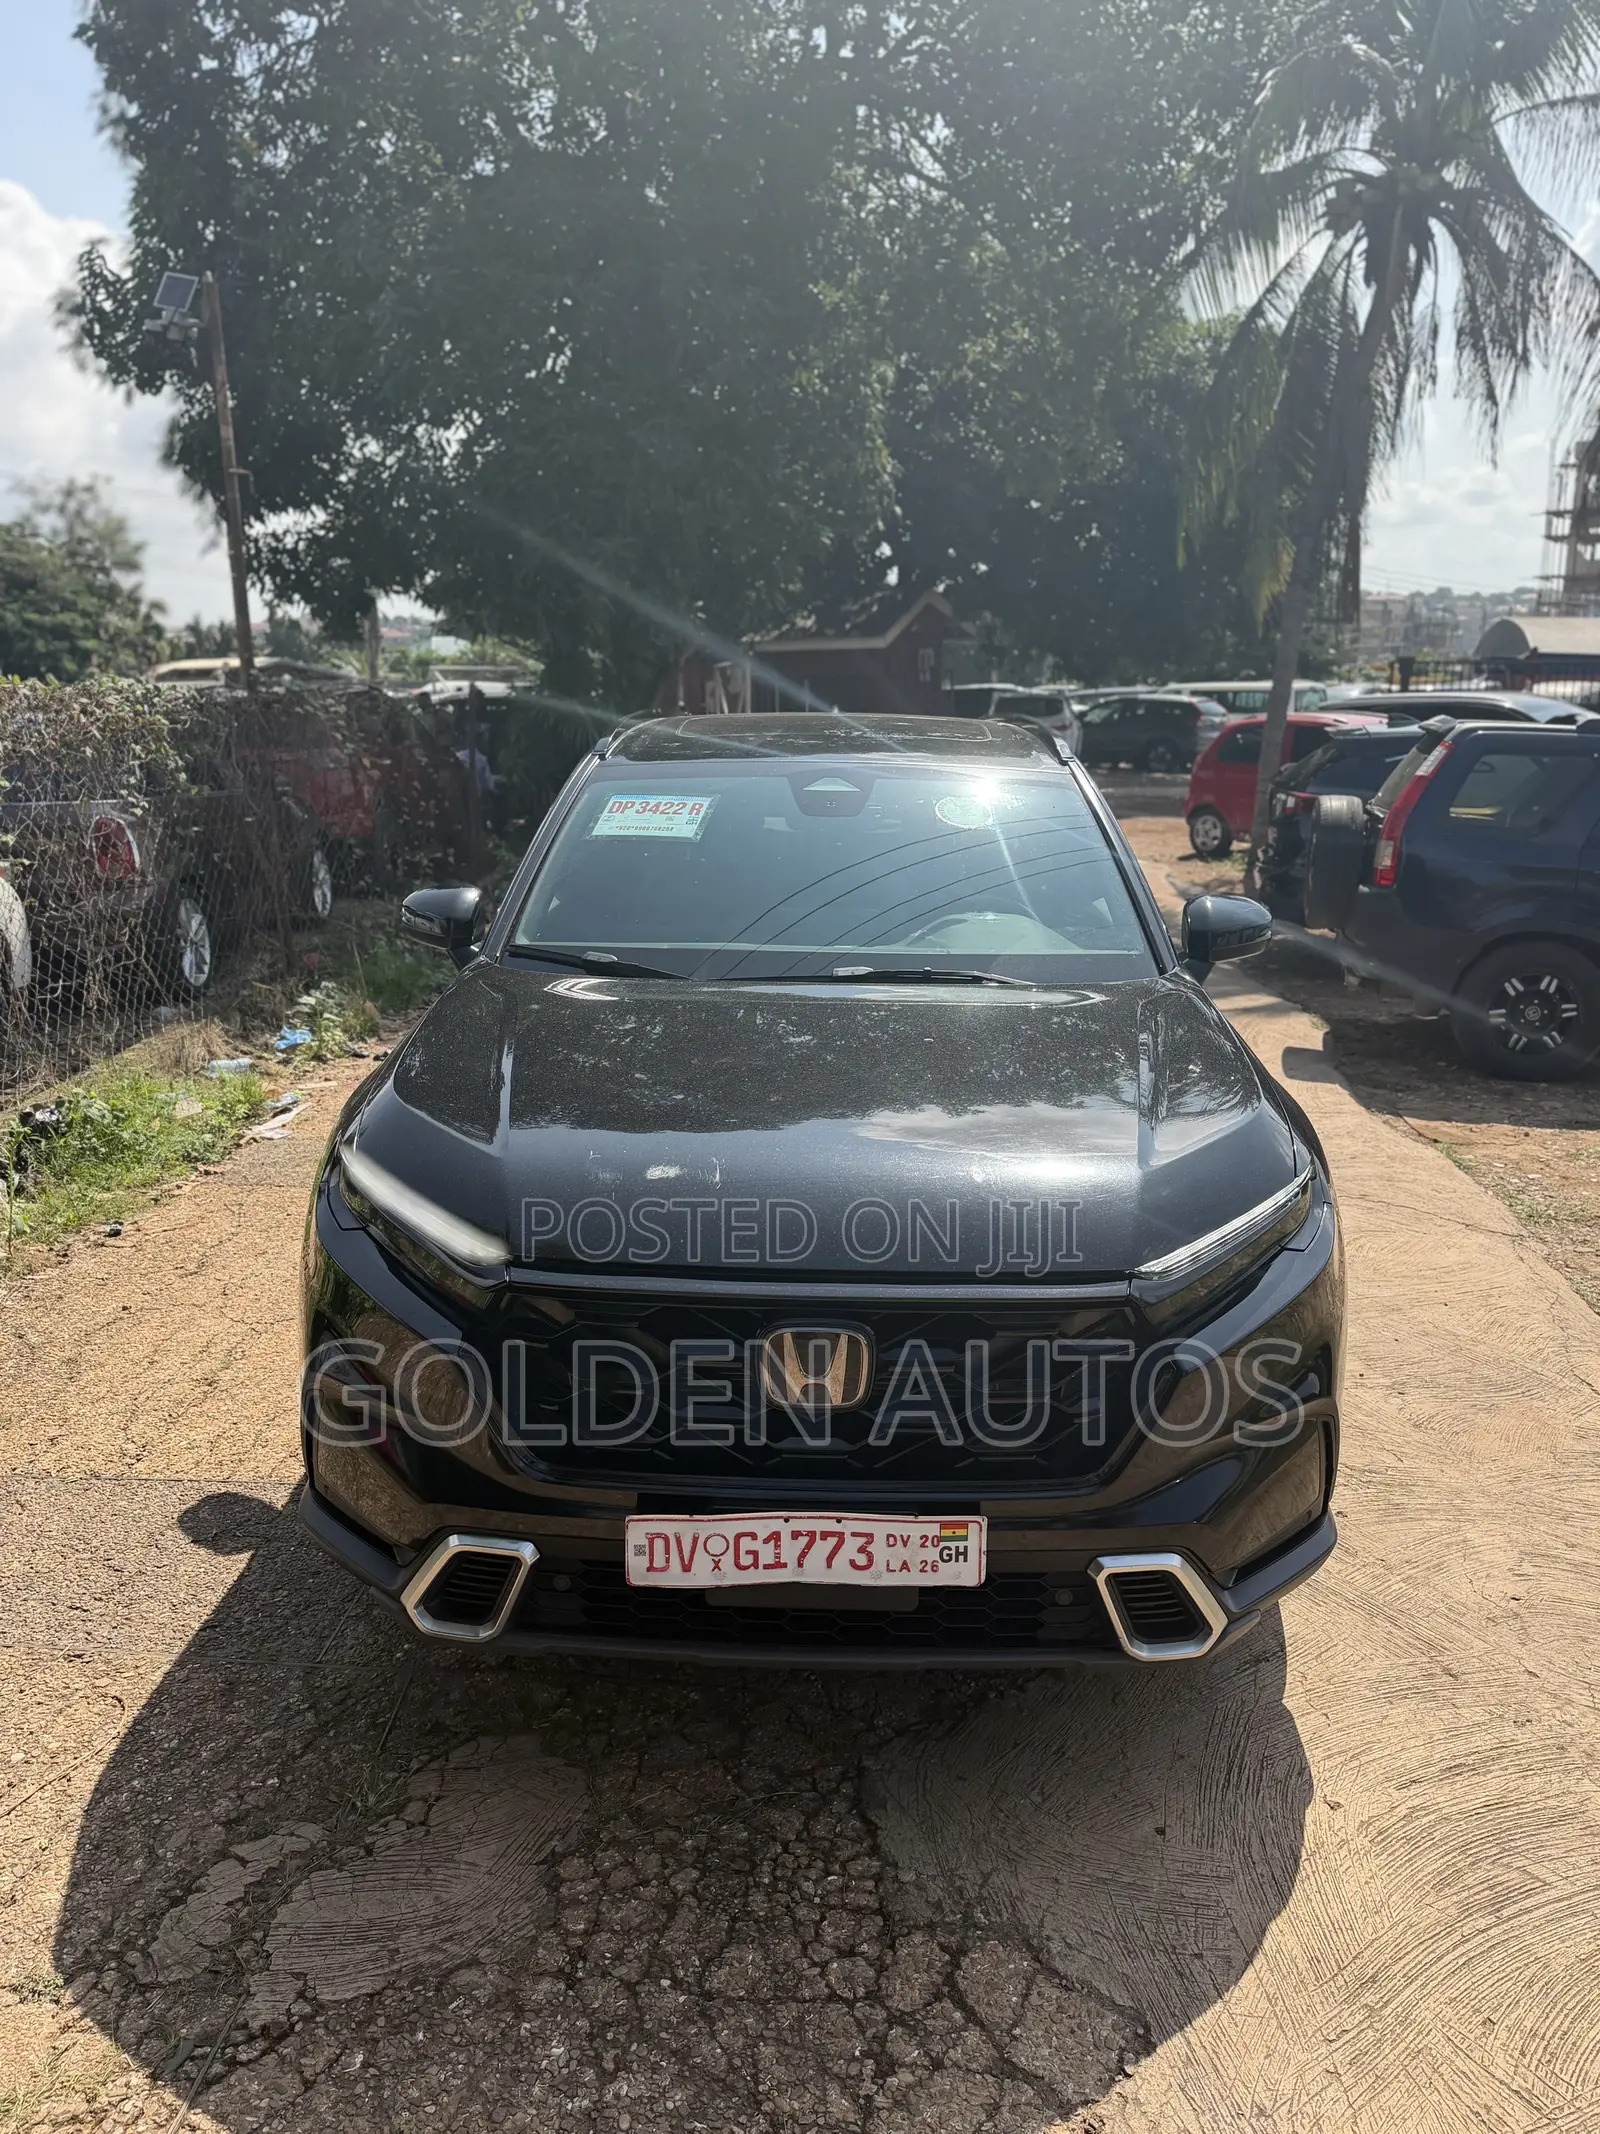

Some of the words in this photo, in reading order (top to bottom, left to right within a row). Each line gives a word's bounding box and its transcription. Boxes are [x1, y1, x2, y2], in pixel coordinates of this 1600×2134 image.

[607, 800, 635, 814] DP
[635, 801, 688, 815] 3422
[688, 802, 704, 816] R
[886, 1533, 911, 1548] DV
[919, 1534, 941, 1549] 20
[645, 1532, 700, 1573] DV
[733, 1530, 874, 1571] G1773
[938, 1545, 969, 1564] GH
[886, 1559, 911, 1573] LA
[919, 1560, 940, 1573] 26
